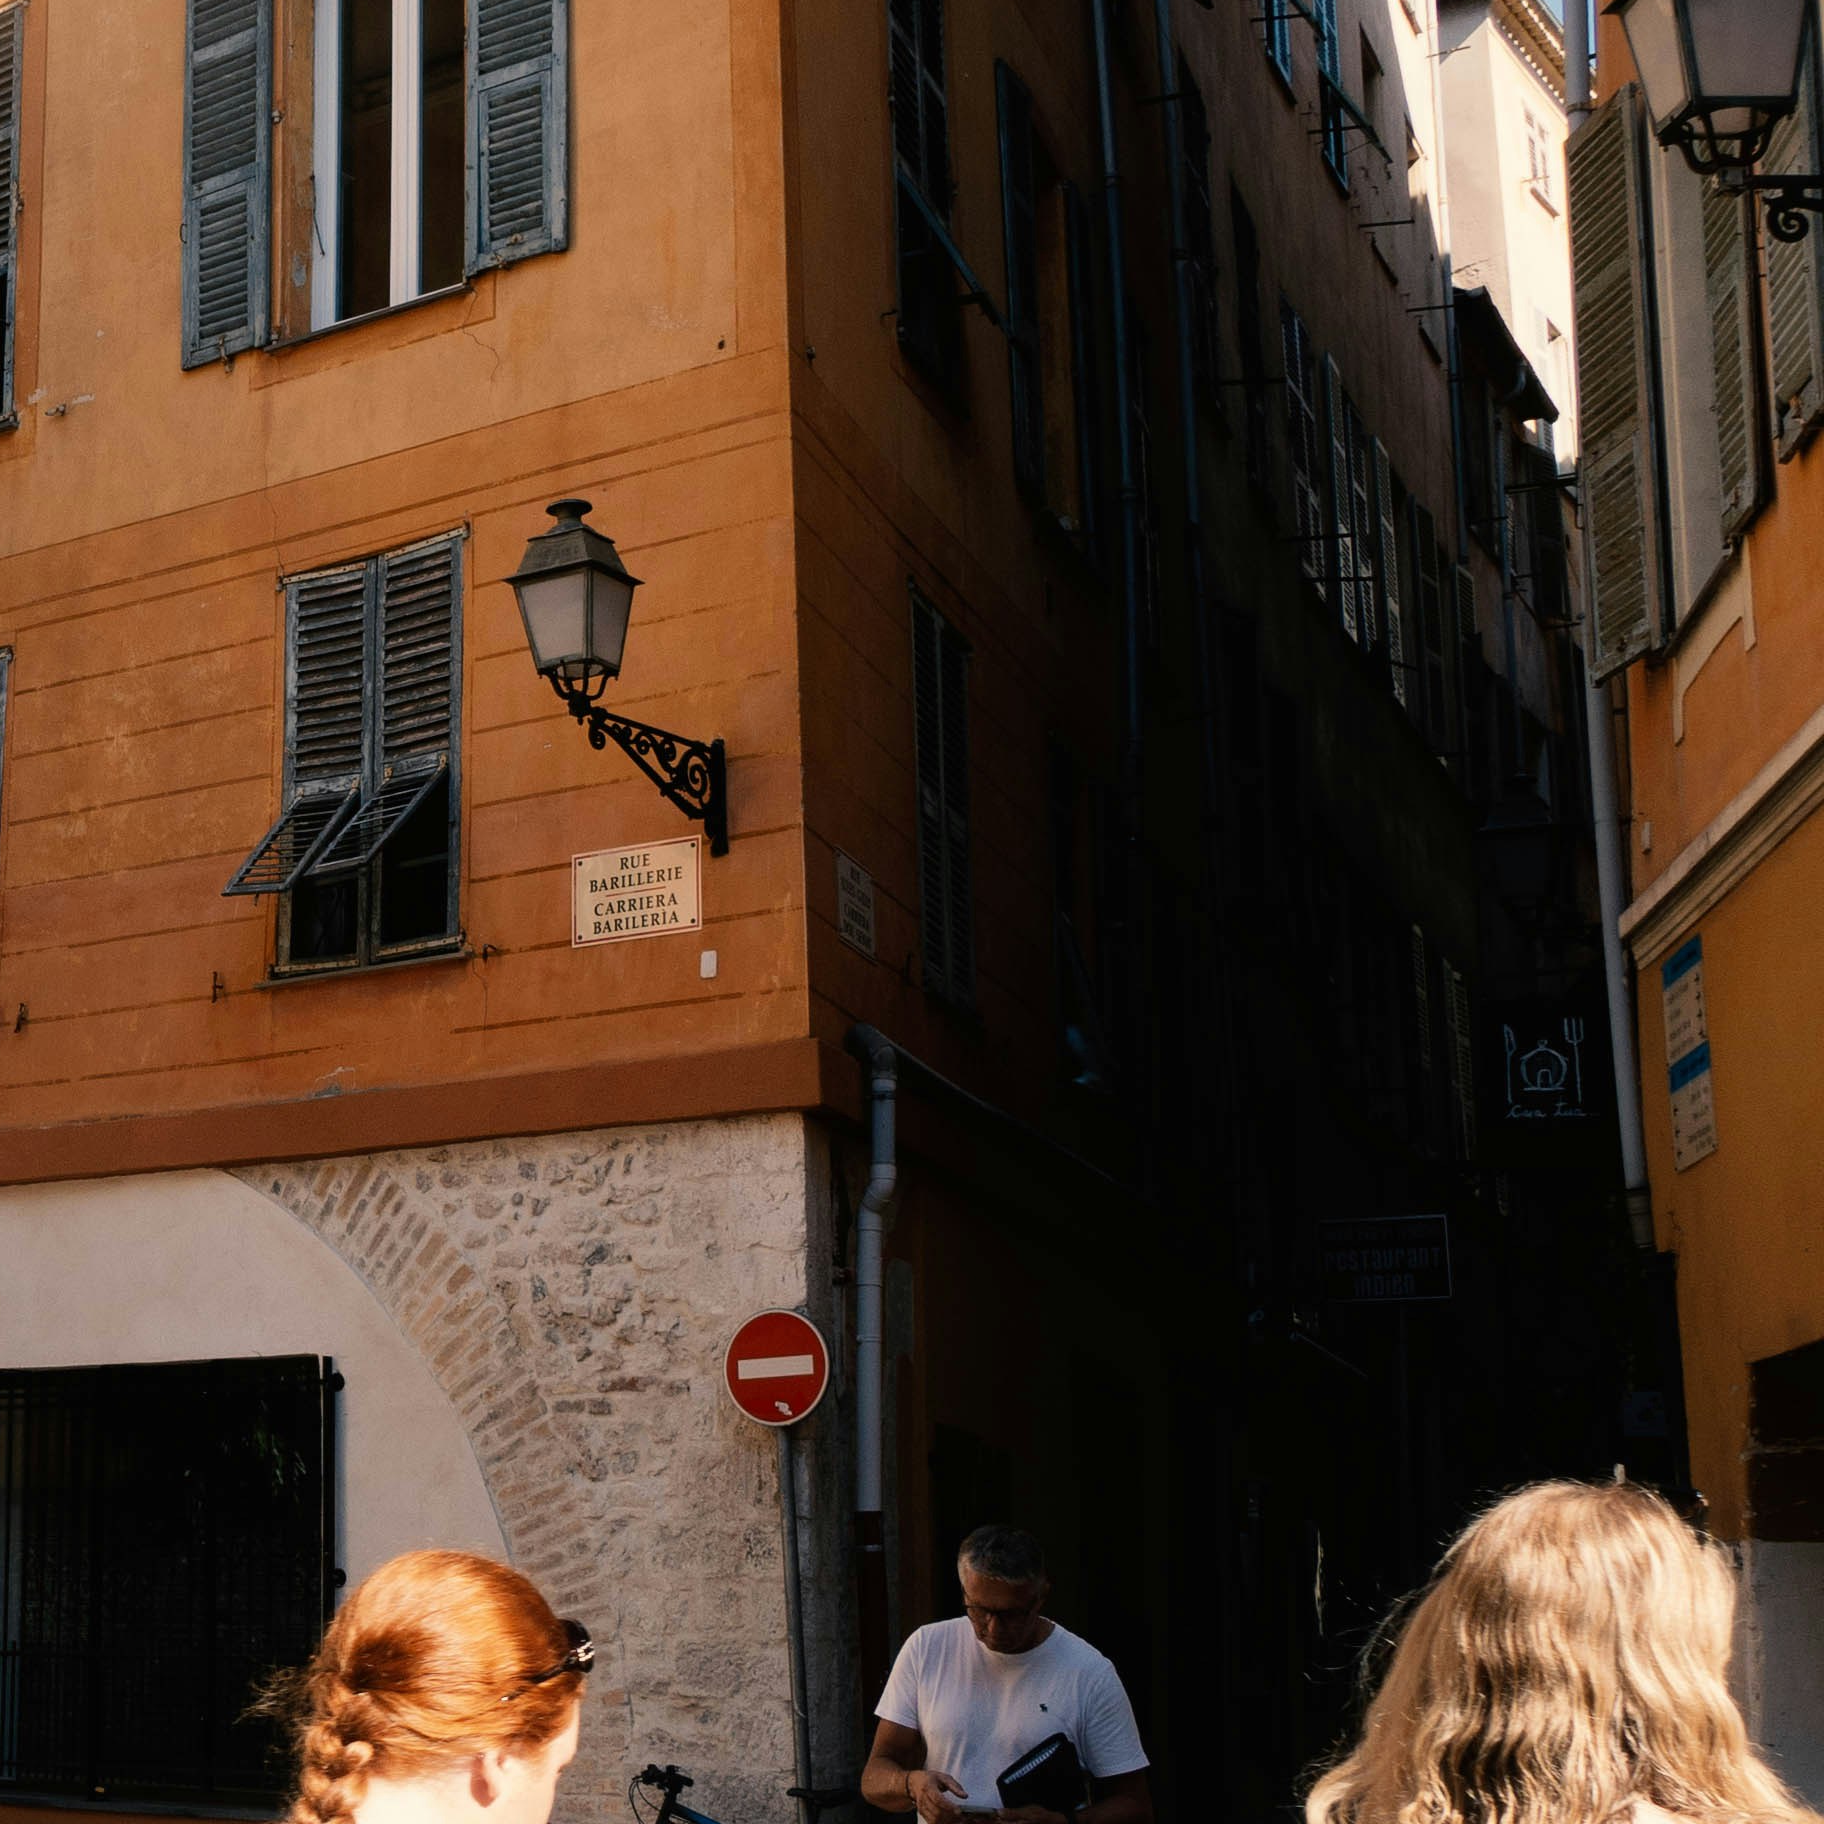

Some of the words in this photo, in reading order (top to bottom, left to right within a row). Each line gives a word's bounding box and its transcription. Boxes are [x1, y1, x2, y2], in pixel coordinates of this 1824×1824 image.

[619, 853, 651, 870] RUE
[589, 866, 683, 893] BARILLERIE
[594, 893, 678, 916] CARRIERA
[592, 909, 679, 935] BARILERÌA
